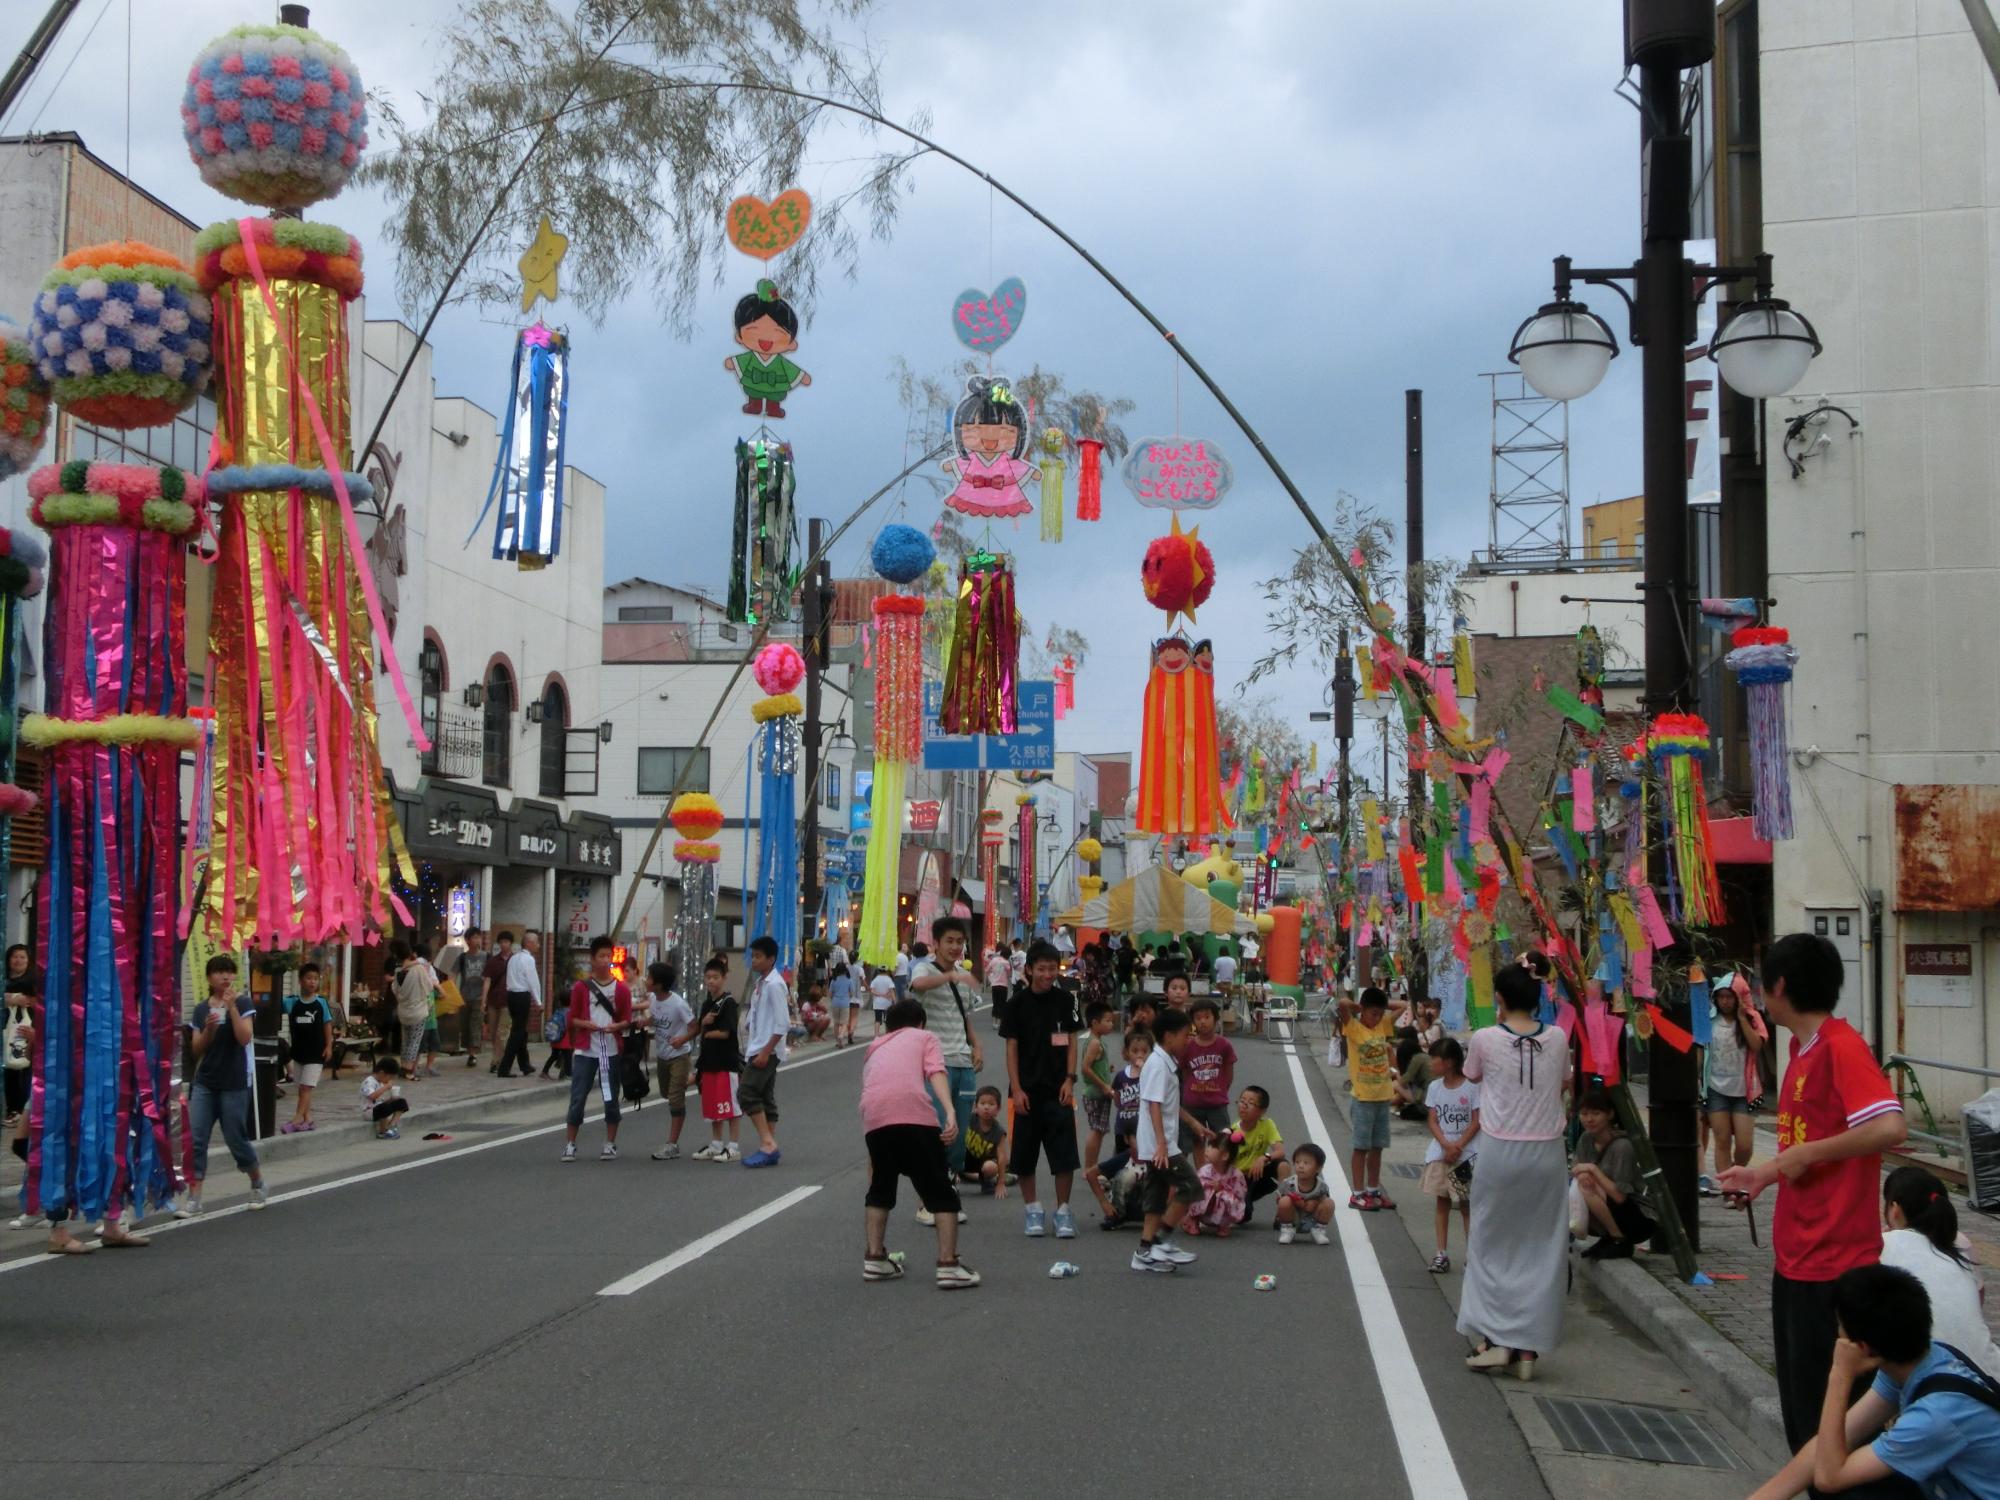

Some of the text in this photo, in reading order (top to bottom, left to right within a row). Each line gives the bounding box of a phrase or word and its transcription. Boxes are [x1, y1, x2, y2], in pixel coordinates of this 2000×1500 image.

[1147, 441, 1208, 464] おひさま
[1159, 462, 1220, 478] みたいな
[1139, 478, 1217, 501] こどもたち
[1008, 745, 1050, 759] 久慈駅
[910, 800, 940, 831] 酒
[453, 890, 465, 938] 欧風パン
[717, 1102, 731, 1114] 33
[1435, 1103, 1470, 1130] Hope
